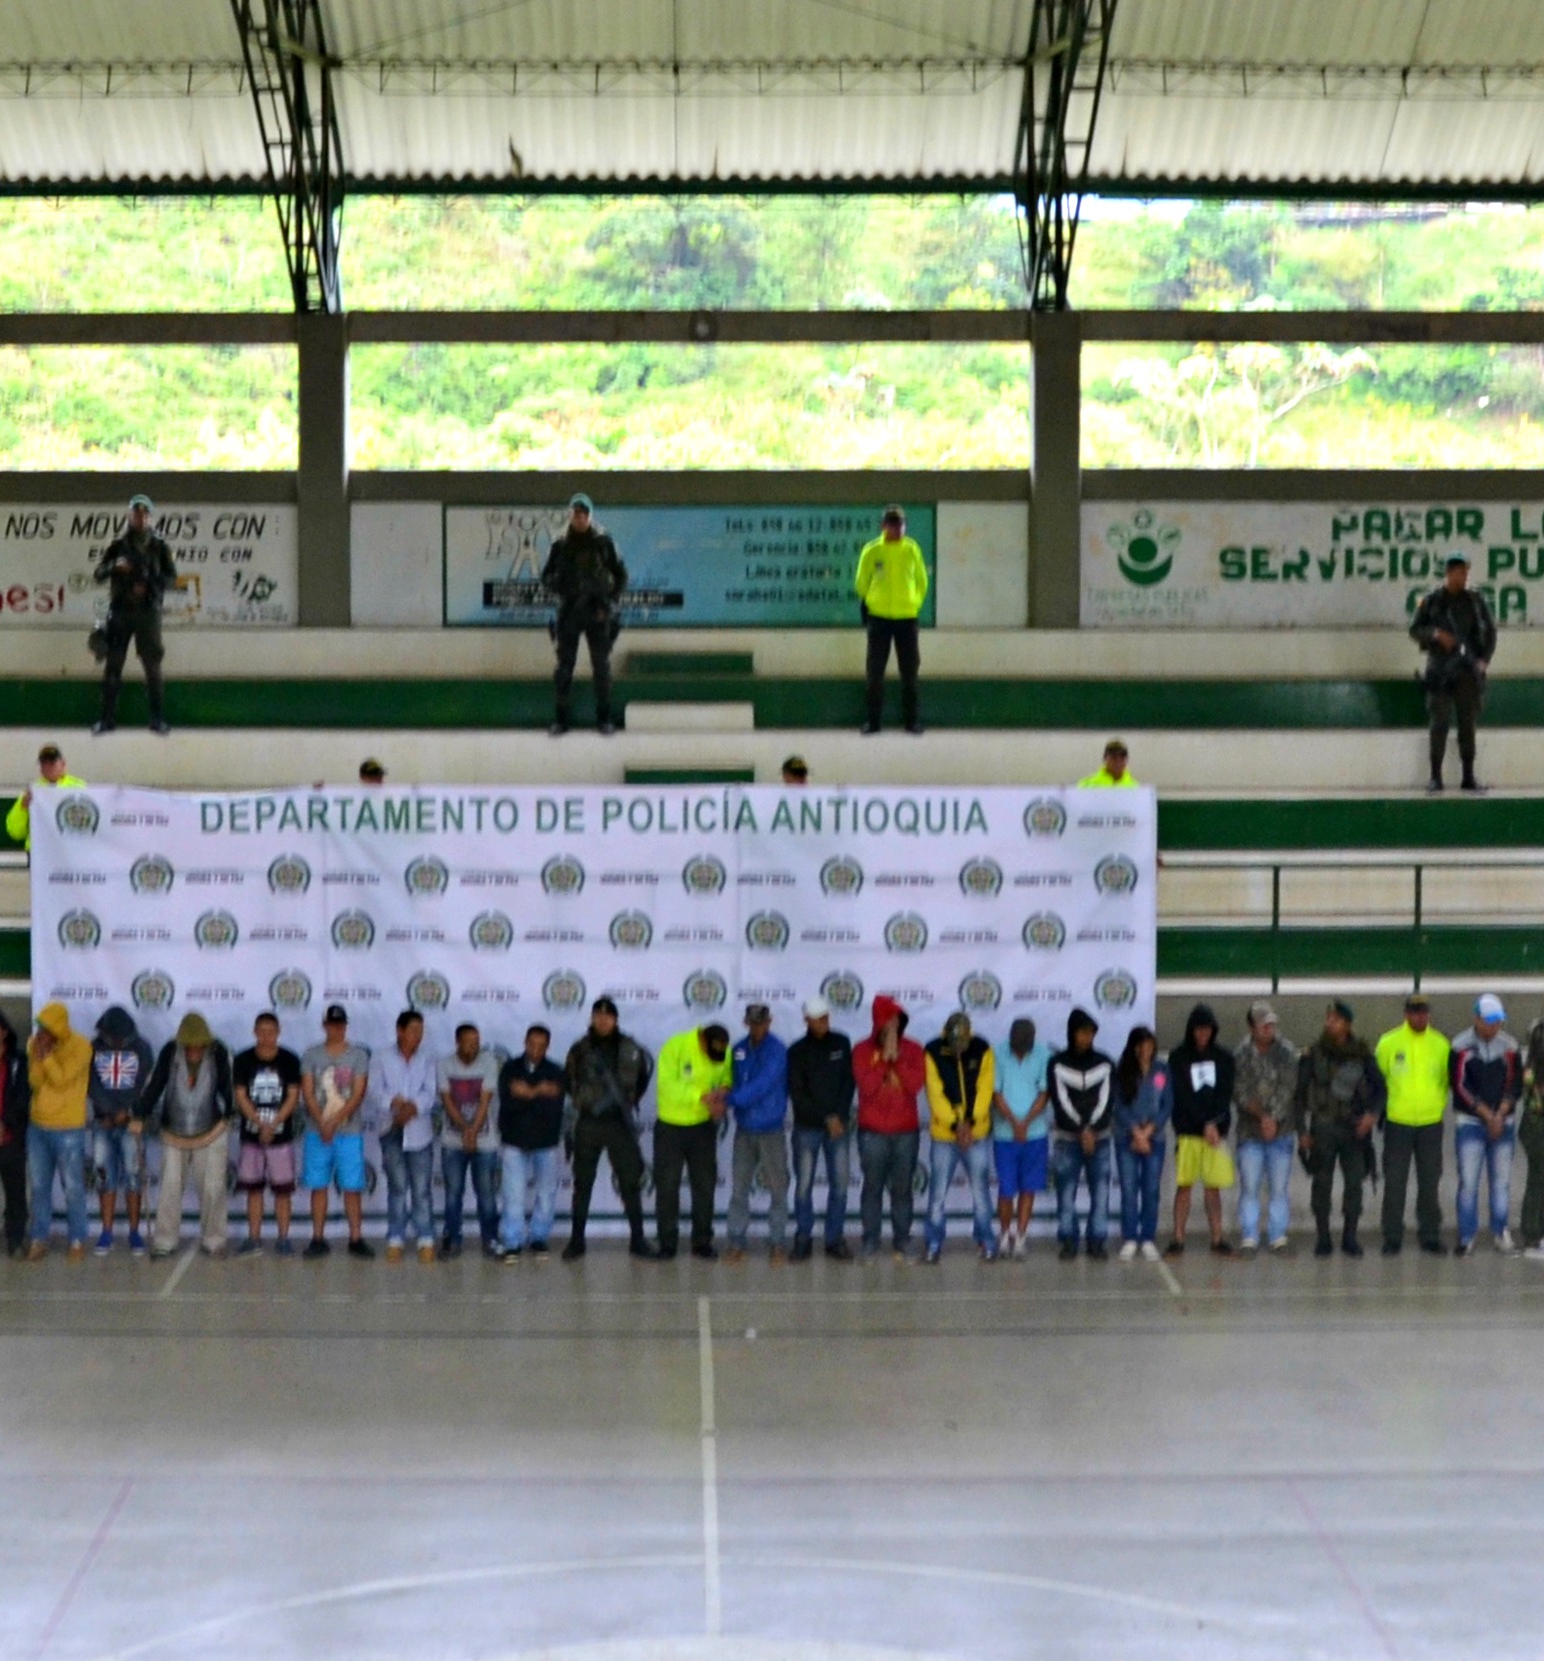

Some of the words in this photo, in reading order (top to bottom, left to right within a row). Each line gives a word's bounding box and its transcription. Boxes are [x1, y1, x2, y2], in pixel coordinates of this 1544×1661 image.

[5, 511, 58, 540] NOS
[220, 549, 253, 563] CON
[200, 796, 518, 834] DEPARTAMENTO
[535, 797, 585, 833] DE
[602, 787, 757, 834] POLICÍA
[770, 797, 989, 837] ANTIOQUIA
